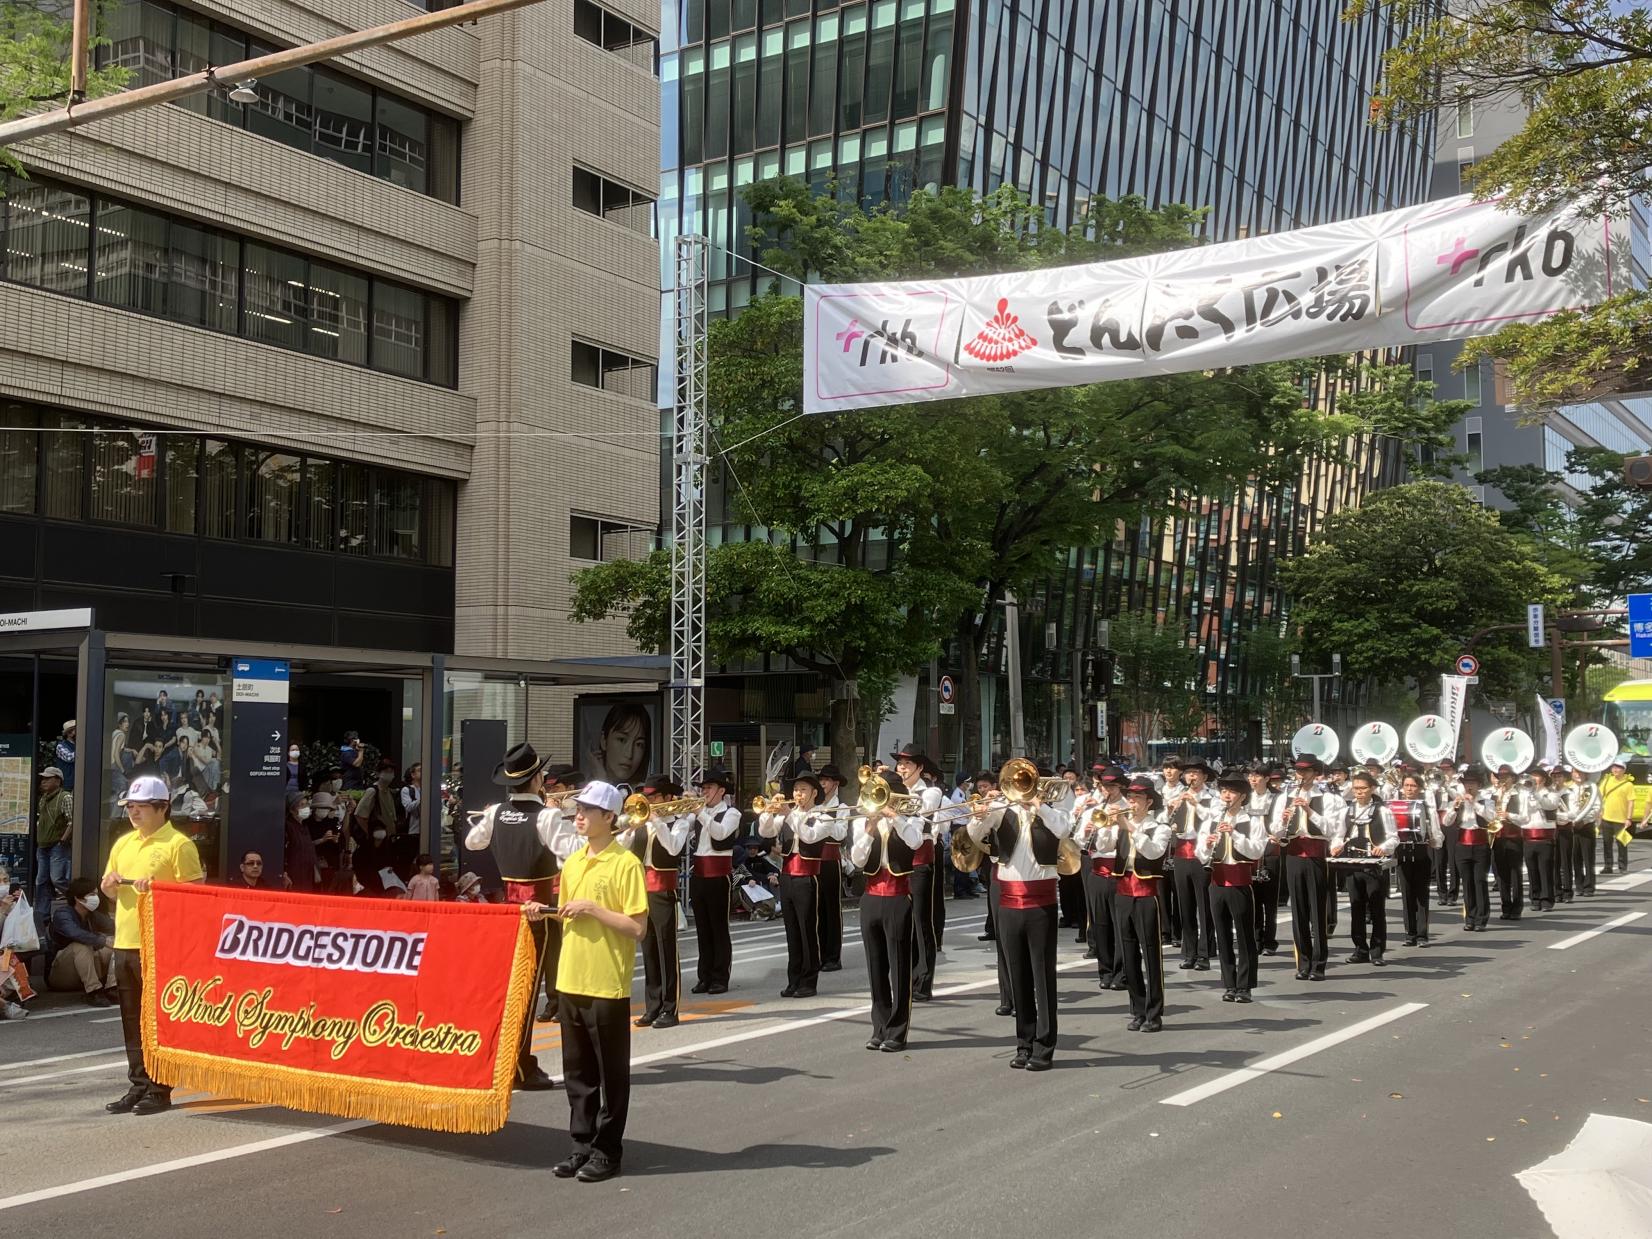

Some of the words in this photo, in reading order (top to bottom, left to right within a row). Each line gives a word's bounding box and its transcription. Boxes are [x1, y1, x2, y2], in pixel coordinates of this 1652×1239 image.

[1474, 217, 1575, 288] rkb
[859, 318, 925, 367] rkb
[1047, 258, 1371, 360] どんたく広場
[217, 917, 426, 972] BRIDGESTONE
[162, 976, 233, 1026] Wind
[236, 987, 360, 1059] Symphony
[361, 1000, 482, 1056] Orchestra
